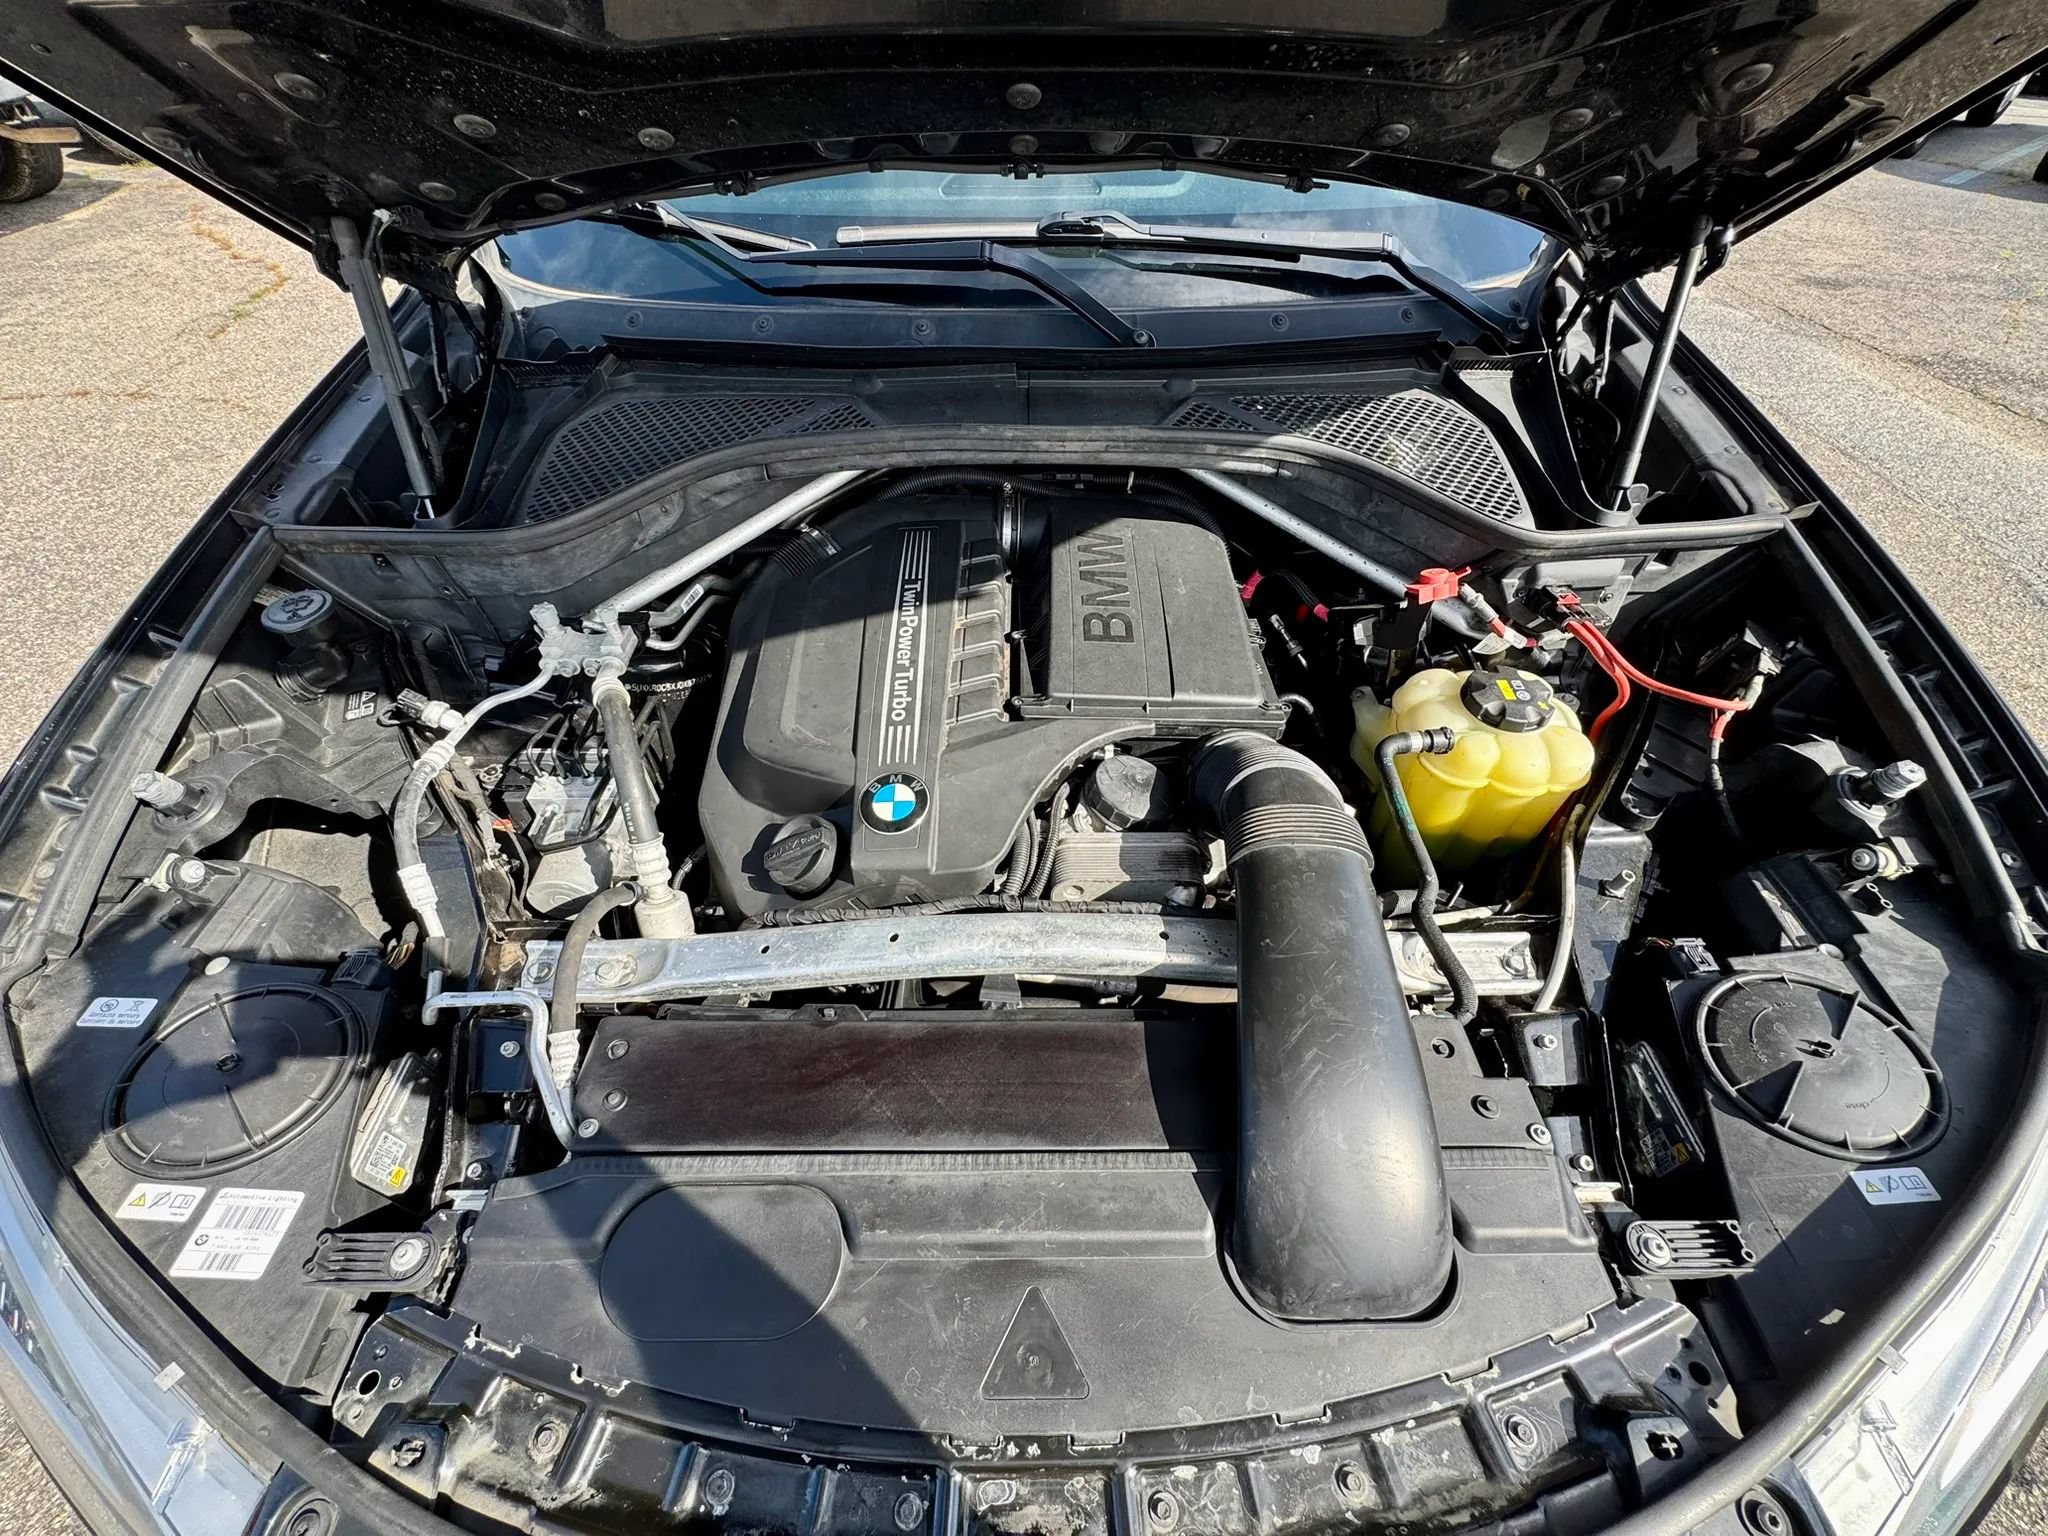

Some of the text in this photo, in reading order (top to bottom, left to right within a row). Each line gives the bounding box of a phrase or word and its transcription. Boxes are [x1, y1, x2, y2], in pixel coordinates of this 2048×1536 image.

[1077, 531, 1135, 643] BMW
[891, 580, 922, 721] TwinPower Turbo
[868, 774, 924, 793] BMW
[268, 1195, 298, 1204] Lighting
